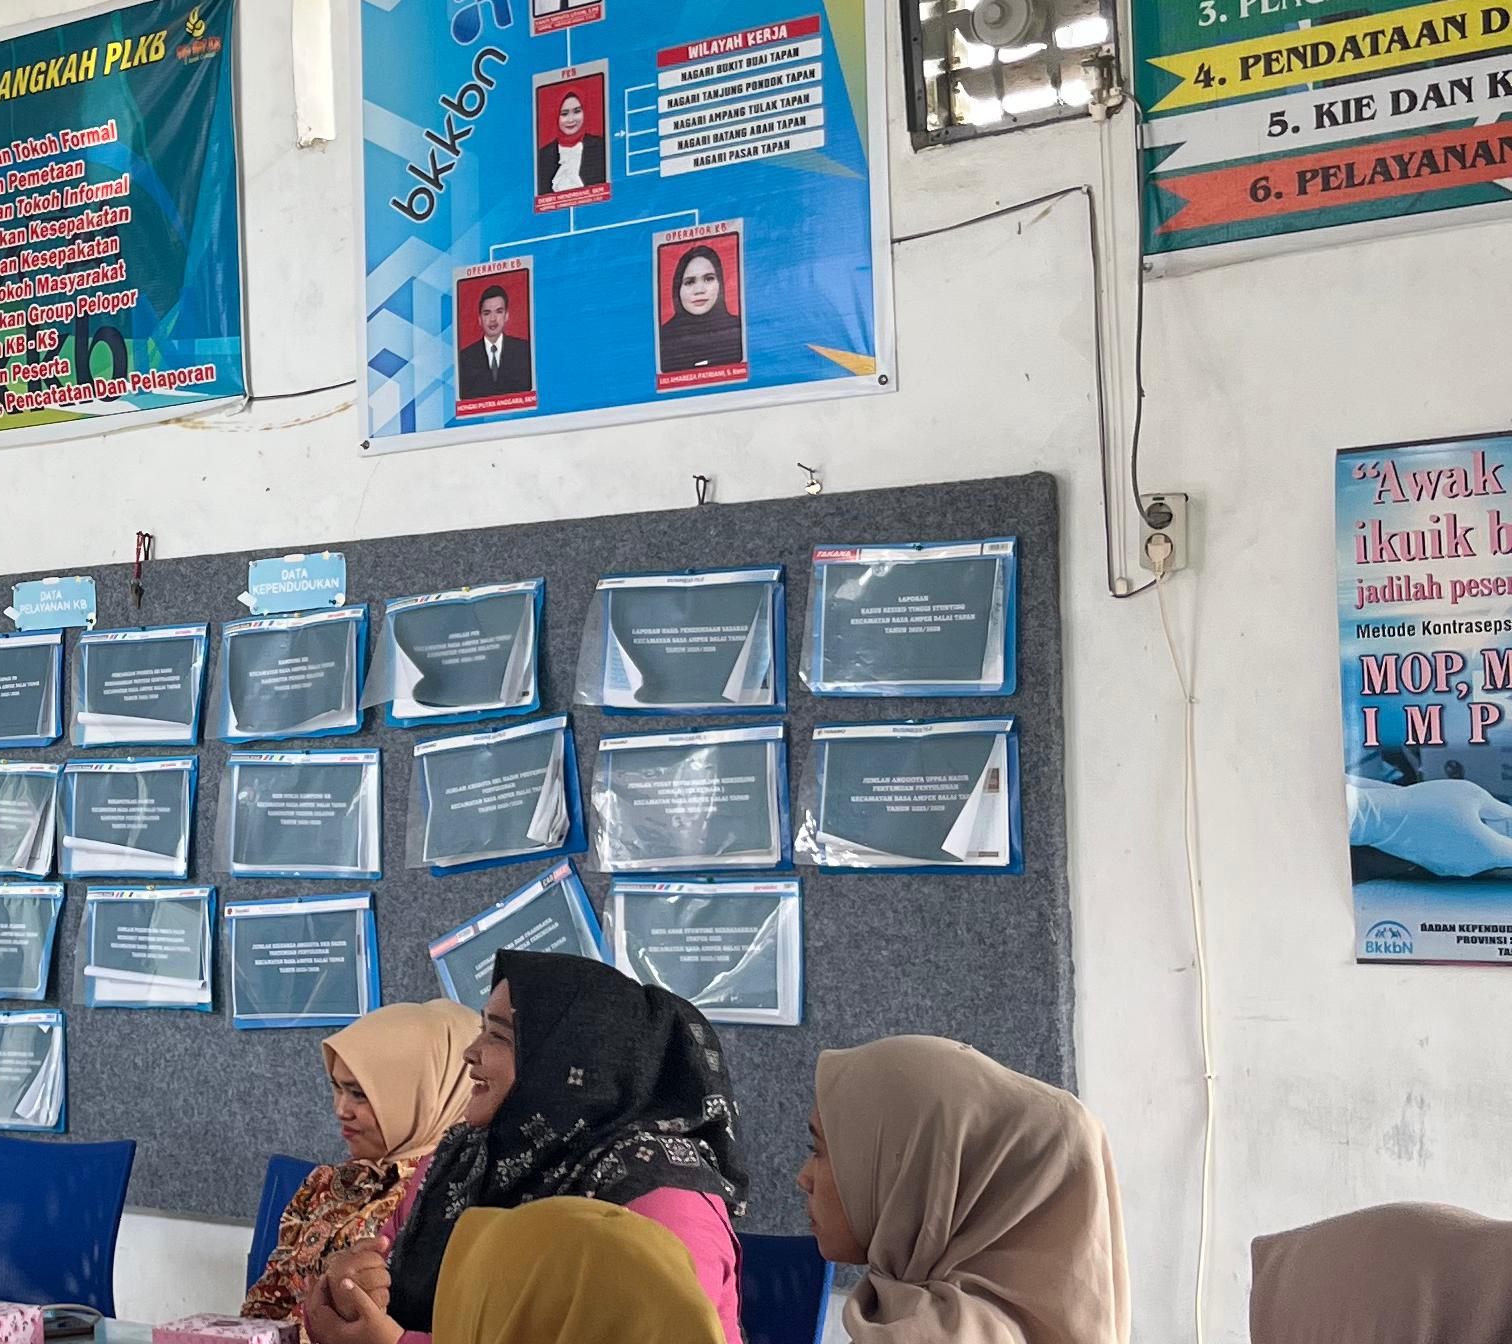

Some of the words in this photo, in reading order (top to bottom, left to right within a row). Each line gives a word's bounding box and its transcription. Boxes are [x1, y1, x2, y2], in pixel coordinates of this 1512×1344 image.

[1198, 0, 1227, 26] 3.
[103, 30, 168, 76] PLKB
[1194, 62, 1226, 89] 4.
[1240, 12, 1467, 80] PENDATAAN
[1268, 112, 1300, 137] 5.
[1314, 94, 1377, 130] KIE
[1390, 77, 1473, 116] DAN
[12, 135, 58, 160] Tokoh
[61, 119, 117, 149] Formal
[391, 47, 507, 222] bkkbn
[693, 152, 726, 167] NAGARI
[729, 146, 758, 160] PASAR
[761, 140, 790, 154] TAPAN
[1250, 176, 1282, 202] 6.
[666, 225, 712, 242] OPERATOR
[714, 223, 727, 233] KB
[12, 360, 70, 385] Peserta
[6, 382, 92, 414] Pencatatan
[96, 376, 127, 400] Dan
[130, 365, 216, 394] Pelaporan
[1354, 513, 1476, 564] ikuik
[253, 577, 339, 596] KEPENDUDUKAN
[281, 568, 308, 580] DATA
[40, 590, 62, 602] DATA
[1355, 573, 1443, 609] jadilah
[1356, 623, 1416, 639] Metode
[1422, 618, 1512, 637] Kontraseps
[1360, 651, 1469, 700] MOP,
[1366, 941, 1413, 954] BkkbN
